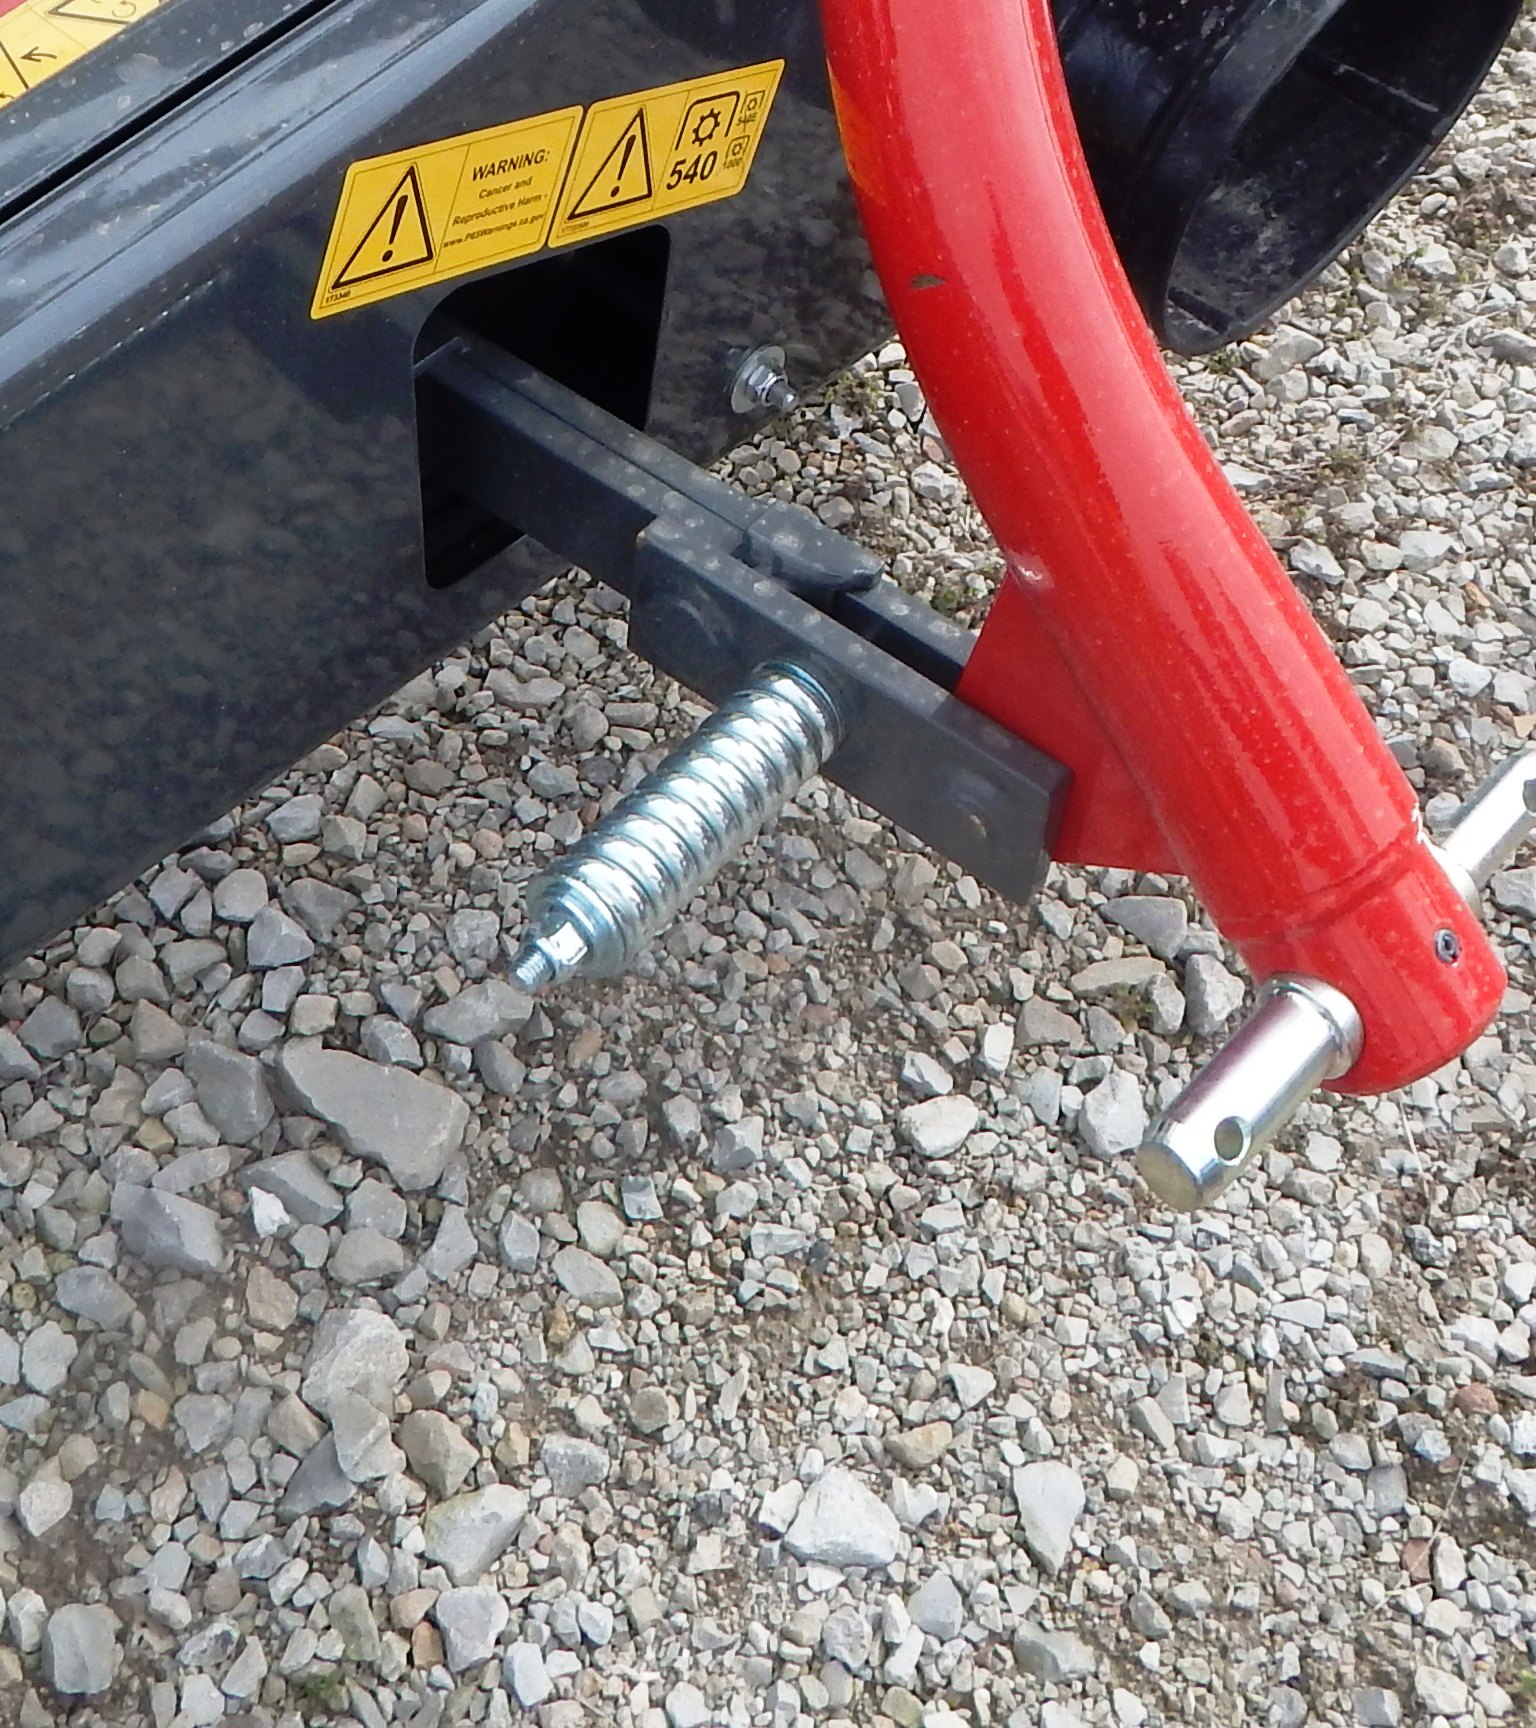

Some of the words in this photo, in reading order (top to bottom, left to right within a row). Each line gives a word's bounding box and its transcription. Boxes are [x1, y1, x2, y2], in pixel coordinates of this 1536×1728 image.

[472, 149, 550, 182] WARNING:
[666, 151, 718, 190] 540
[478, 183, 512, 199] Cancer
[514, 176, 533, 189] and
[452, 202, 516, 226] Reproductive
[517, 194, 542, 207] Harm
